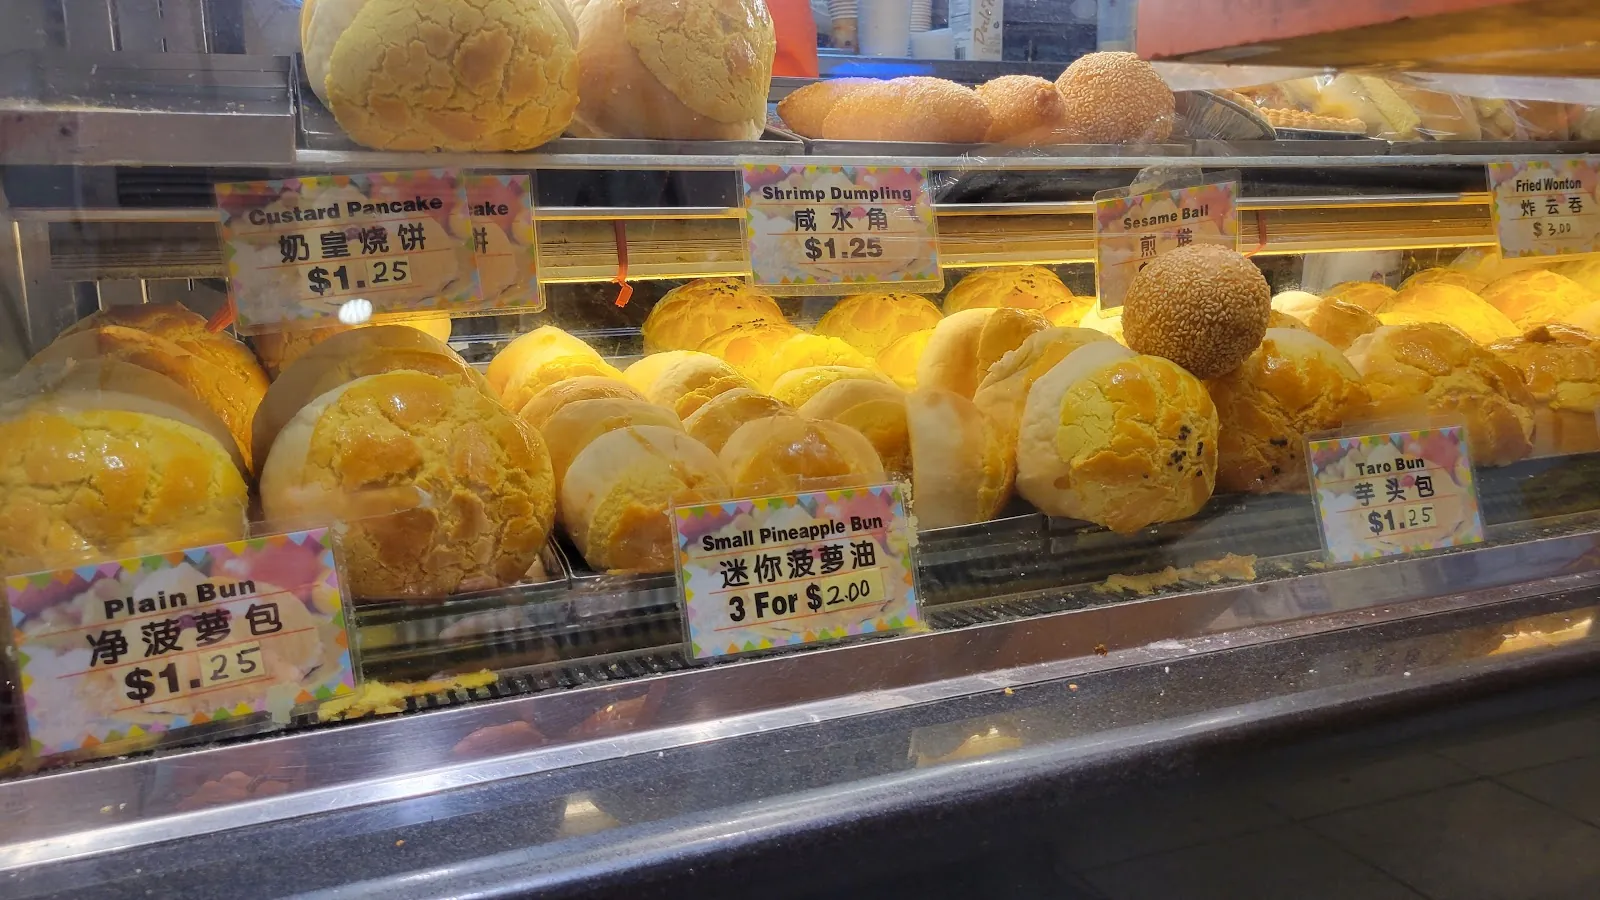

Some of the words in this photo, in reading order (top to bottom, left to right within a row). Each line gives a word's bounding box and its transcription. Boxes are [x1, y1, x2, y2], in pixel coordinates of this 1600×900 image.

[762, 186, 825, 202] Shrimp
[830, 186, 912, 202] Dumpling
[1516, 179, 1541, 192] Fried
[1543, 178, 1582, 191] Wonton
[249, 202, 341, 226] Custard
[347, 195, 443, 218] Pancake
[794, 207, 888, 232] 咸水角
[1123, 212, 1178, 231] Sesame
[1181, 204, 1209, 220] Ball
[1521, 197, 1583, 217] 炸云吞
[278, 222, 427, 264] 奶皇烧饼
[804, 236, 884, 261] $1.25
[307, 260, 409, 296] $1.25
[1356, 462, 1391, 476] Taro
[1394, 457, 1425, 471] Bun
[1354, 475, 1435, 507] 芋头包
[702, 530, 754, 552] Small
[759, 519, 845, 544] Pineapple
[850, 515, 883, 532] Bun
[1368, 507, 1433, 536] $1.25
[719, 539, 876, 589] 迷你菠萝油
[104, 590, 187, 619] Plain
[196, 580, 256, 604] Bun
[728, 596, 746, 622] 3
[754, 591, 798, 619] For
[806, 579, 870, 613] $2.00
[86, 602, 283, 667] 净菠萝包
[124, 646, 261, 704] $1.25
